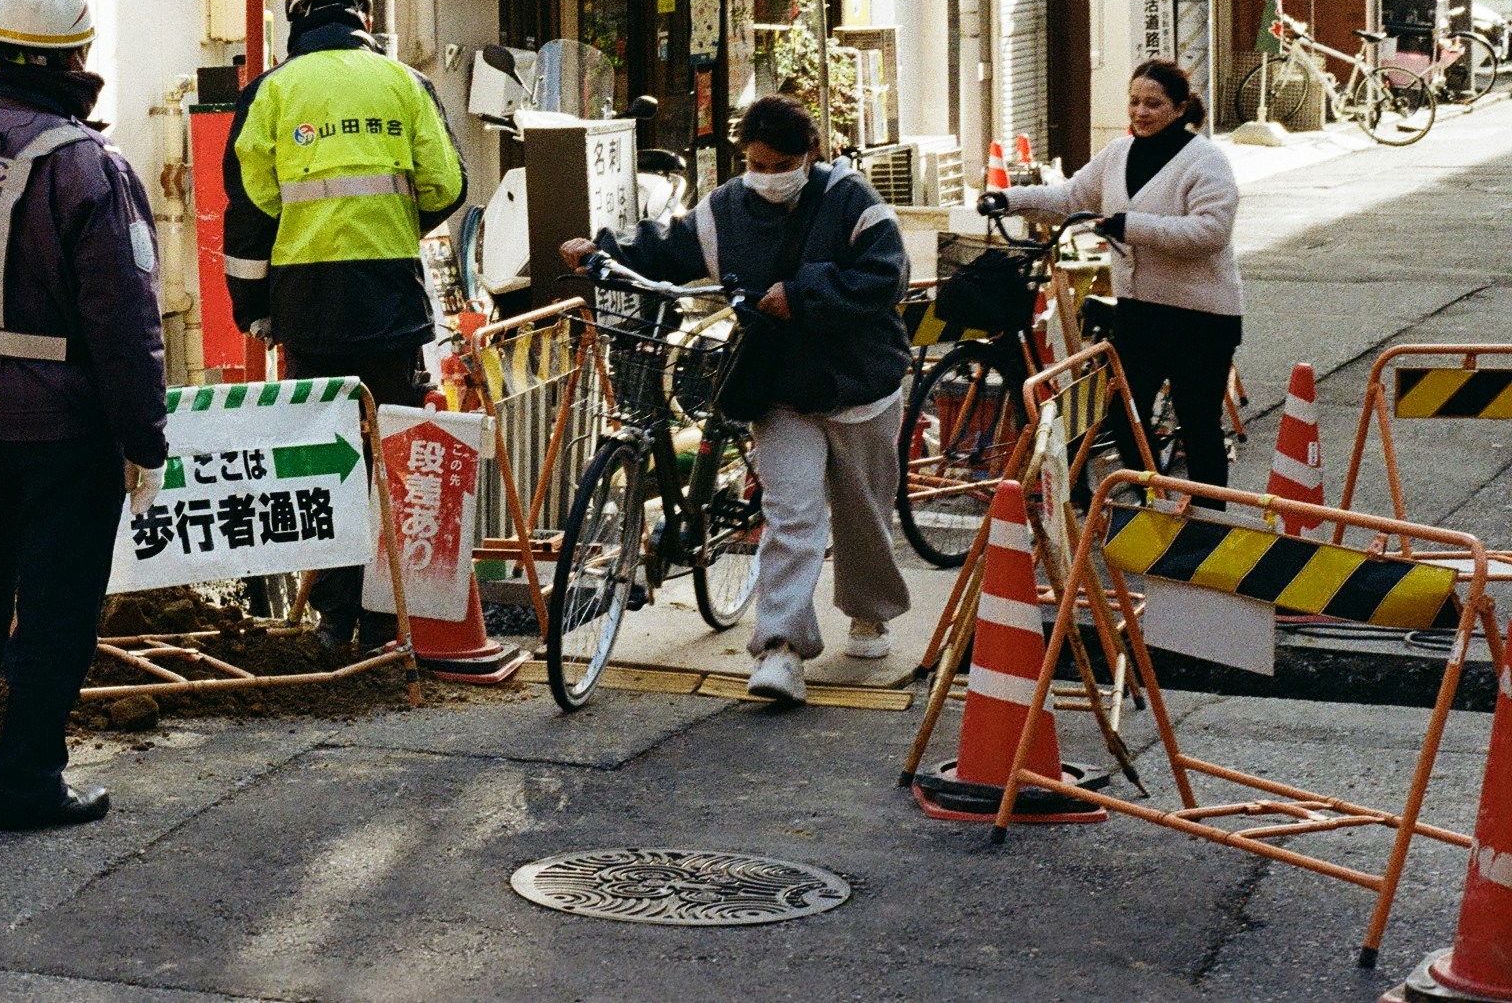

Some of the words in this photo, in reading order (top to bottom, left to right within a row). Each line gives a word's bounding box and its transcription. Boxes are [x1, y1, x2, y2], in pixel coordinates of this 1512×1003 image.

[319, 117, 403, 139] 山田商会
[192, 447, 268, 485] ここは
[448, 443, 464, 487] この先
[131, 487, 336, 561] 歩行者通路
[402, 438, 446, 572] 段差あり
